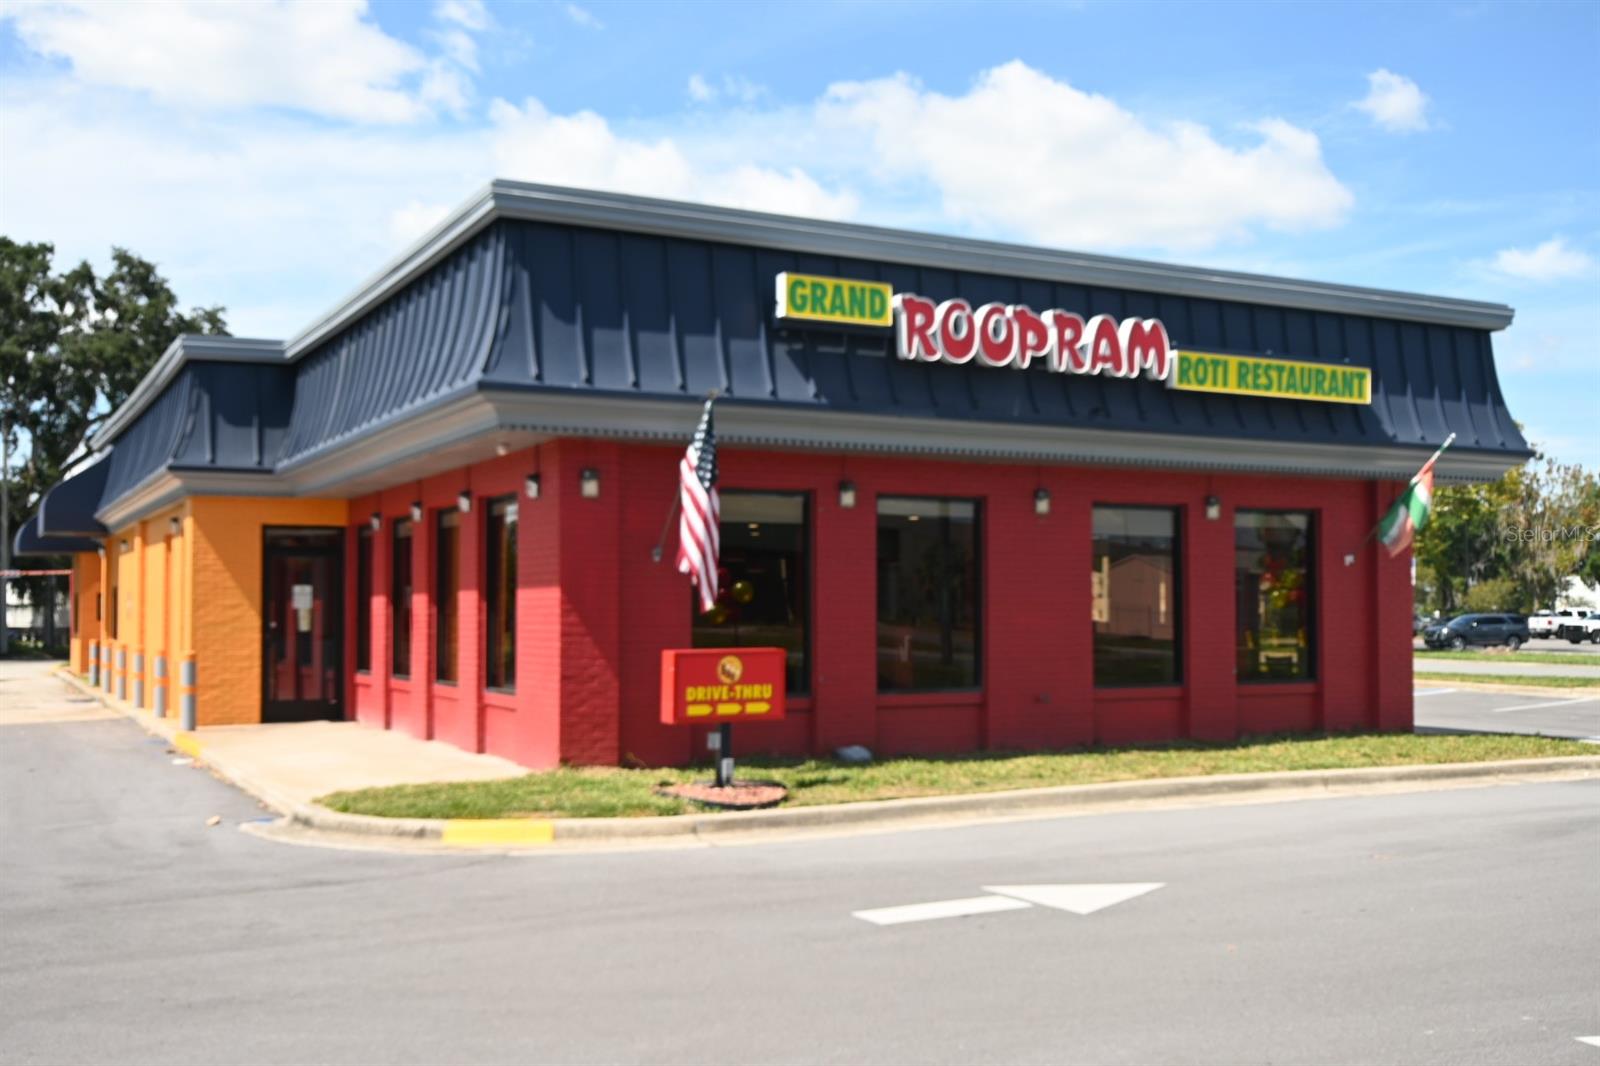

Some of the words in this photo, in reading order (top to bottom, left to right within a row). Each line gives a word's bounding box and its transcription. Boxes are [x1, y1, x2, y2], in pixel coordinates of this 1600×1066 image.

[788, 279, 888, 320] GRAND
[898, 294, 1169, 379] ROOPRAM
[1178, 355, 1229, 388] ROTI
[1237, 361, 1367, 399] RESTAURANT
[686, 683, 772, 701] DRIVE-THRU
